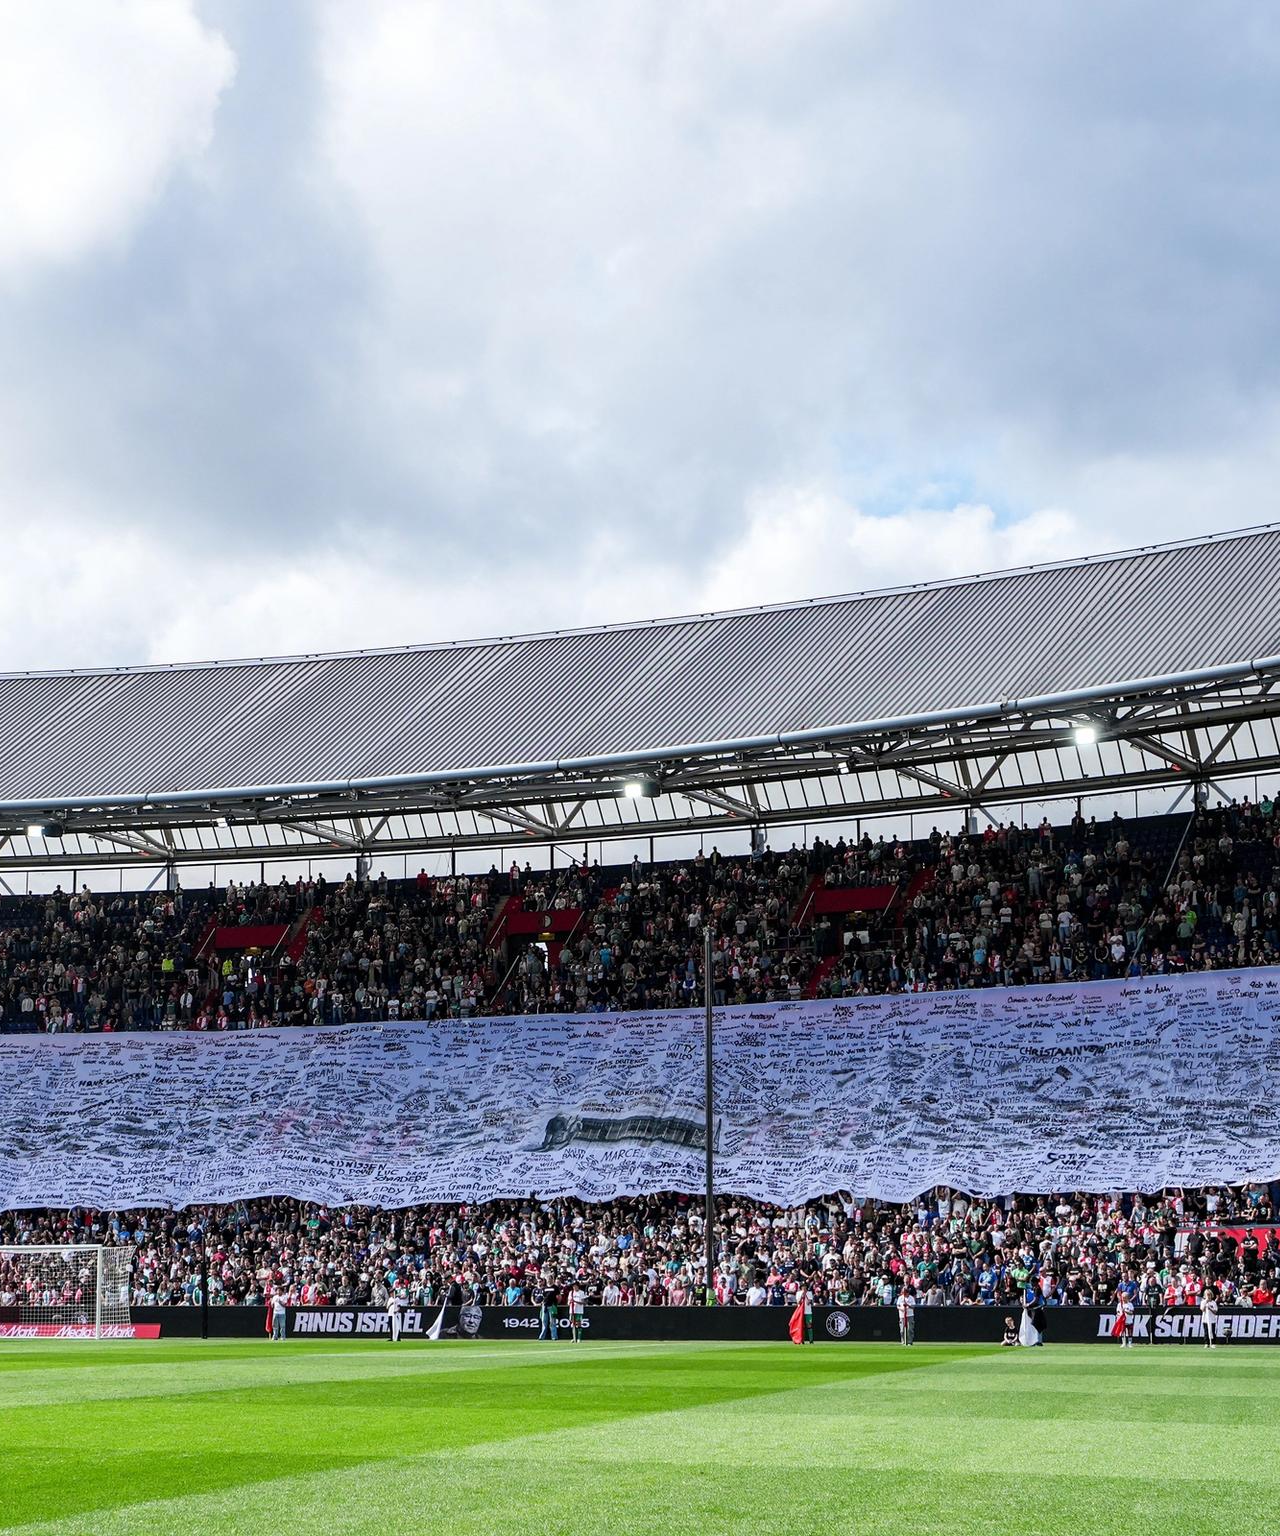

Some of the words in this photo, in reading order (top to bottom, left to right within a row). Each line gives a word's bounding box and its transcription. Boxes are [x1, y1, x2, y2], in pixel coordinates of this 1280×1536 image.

[667, 1044, 697, 1053] KITTY
[409, 1192, 464, 1203] MARIANNE
[293, 1312, 354, 1332] RINUS
[1097, 1315, 1151, 1337] DK
[6, 1325, 38, 1337] Markt
[55, 1325, 95, 1338] Media
[101, 1325, 135, 1338] Markt
